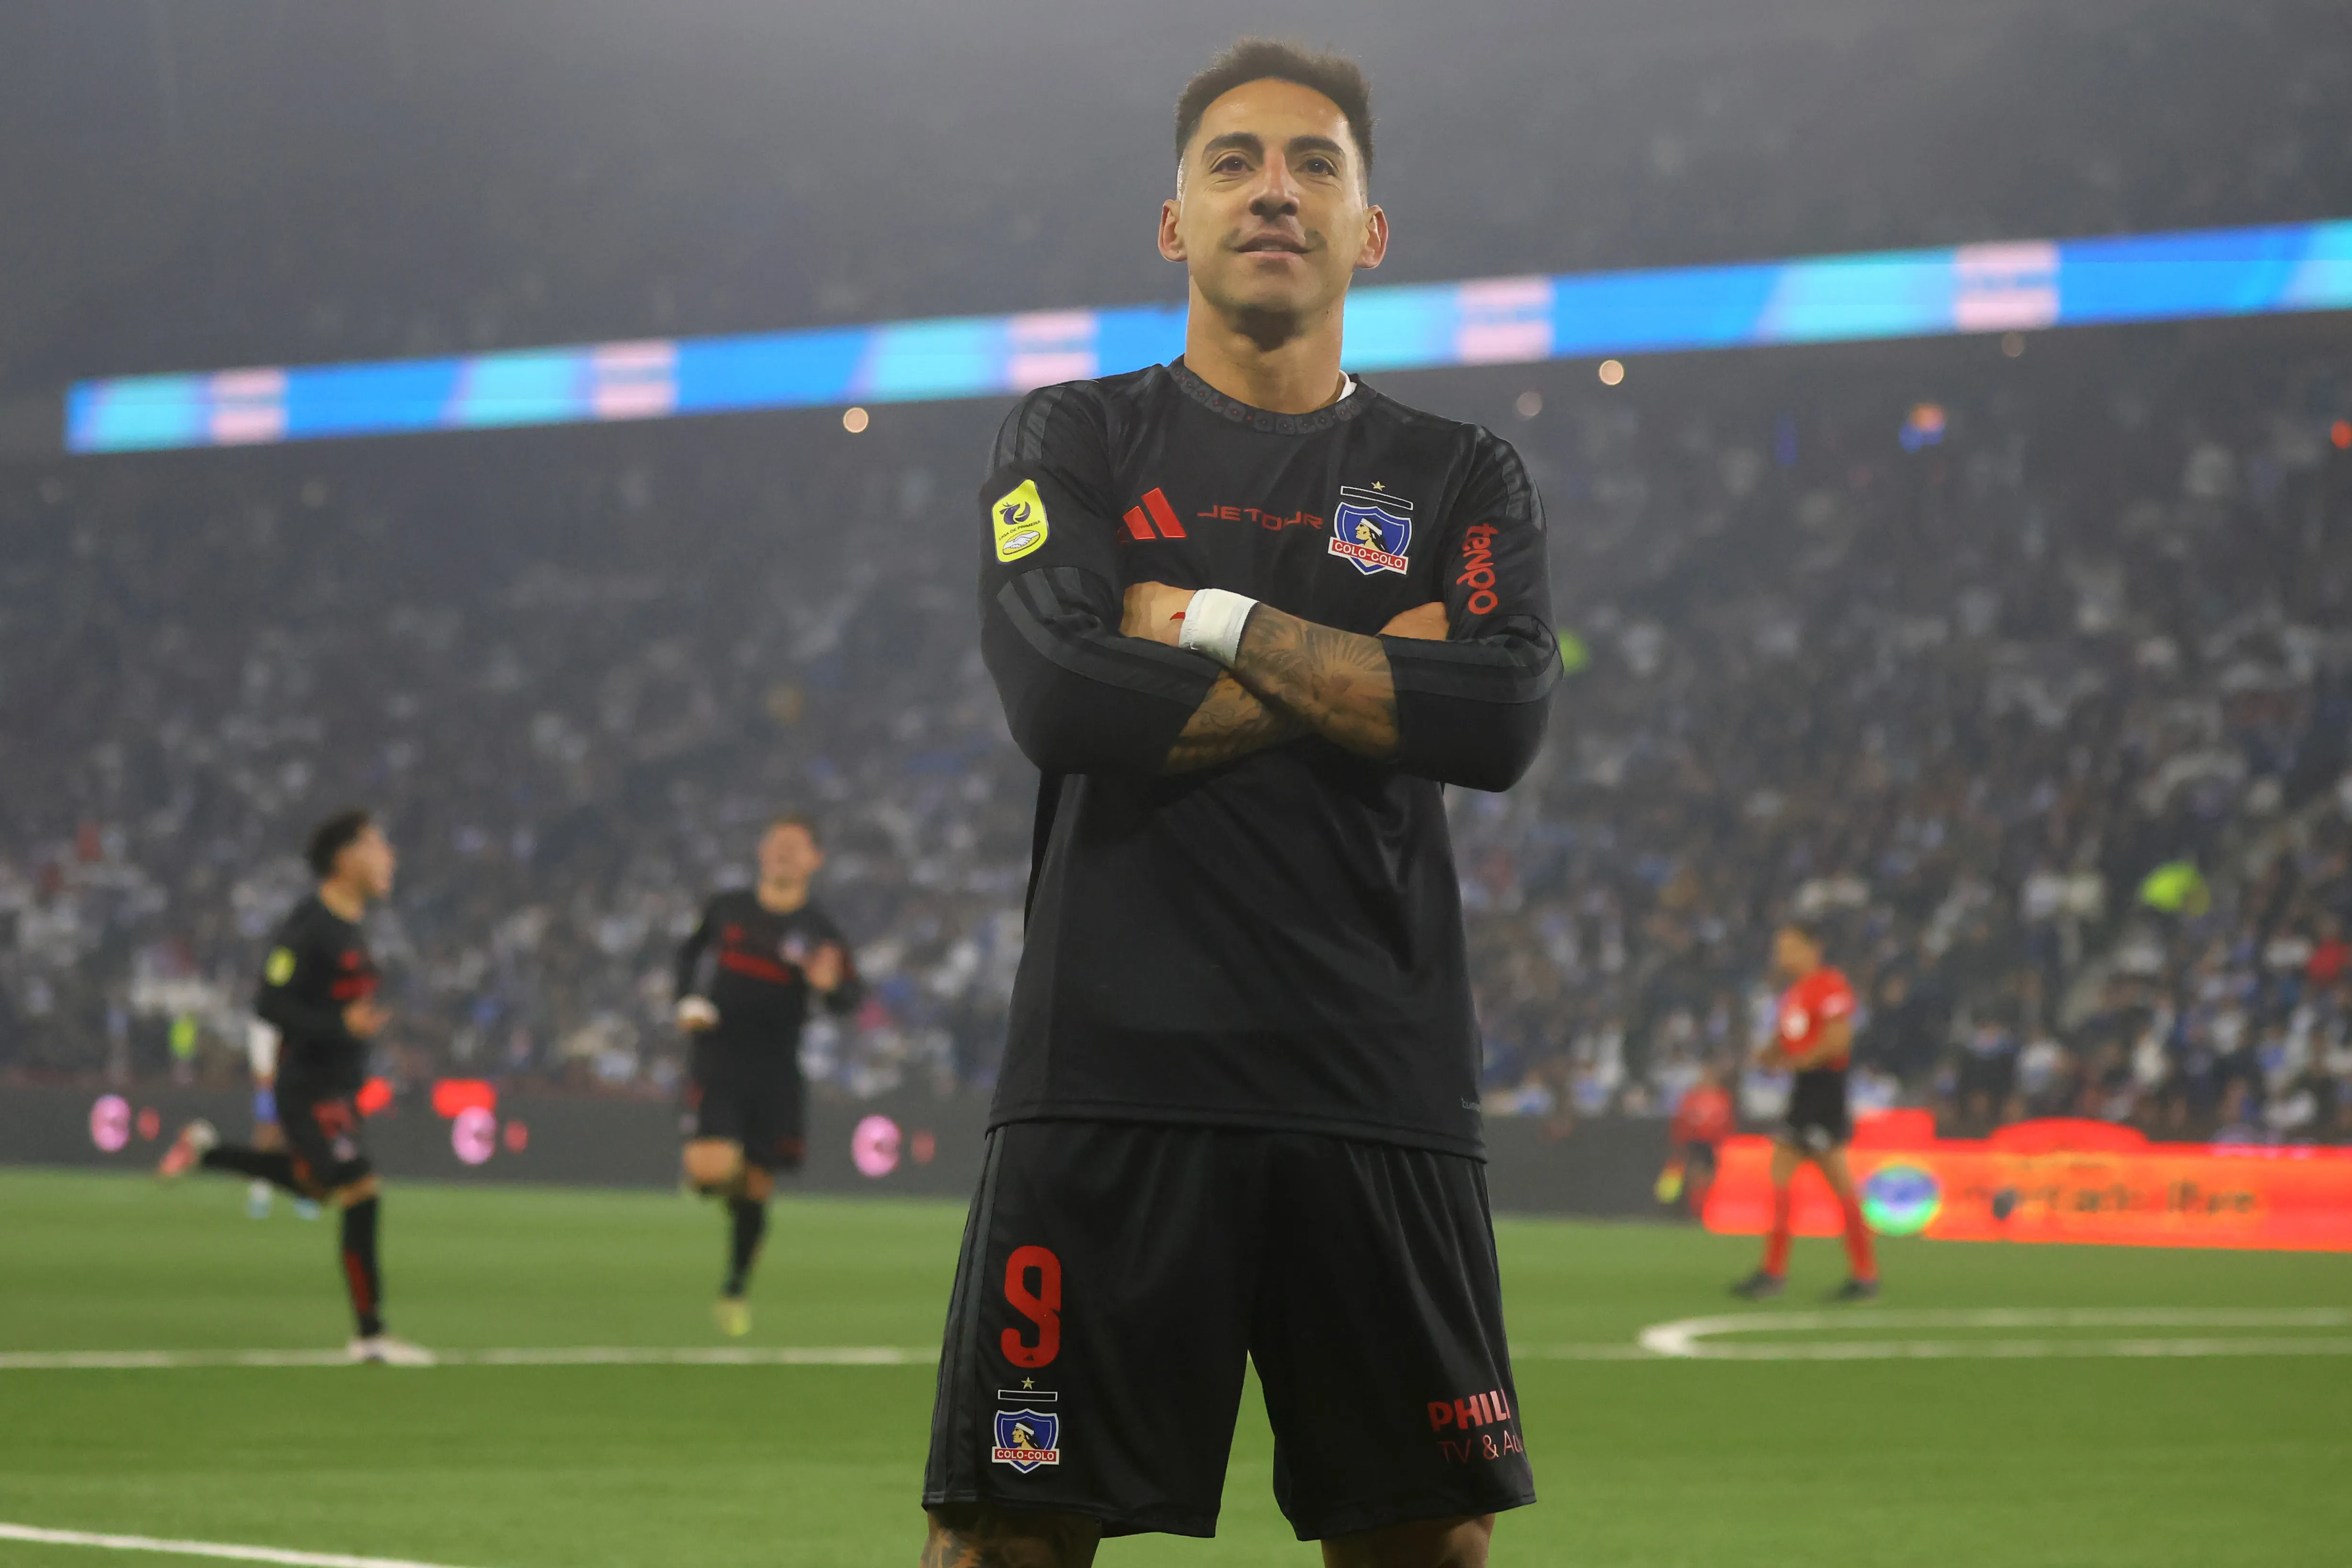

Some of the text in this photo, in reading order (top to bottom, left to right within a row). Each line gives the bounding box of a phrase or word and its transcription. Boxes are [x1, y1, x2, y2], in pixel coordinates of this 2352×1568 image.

[999, 532, 1009, 540] LIGA
[1017, 520, 1040, 529] PRIMERA
[1197, 504, 1324, 530] JETOUR
[1334, 542, 1403, 569] COLO-COLO
[1000, 1245, 1062, 1368] 9
[997, 1450, 1054, 1461] COLO-COLO
[1436, 1439, 1471, 1465] TV
[1482, 1434, 1499, 1460] &
